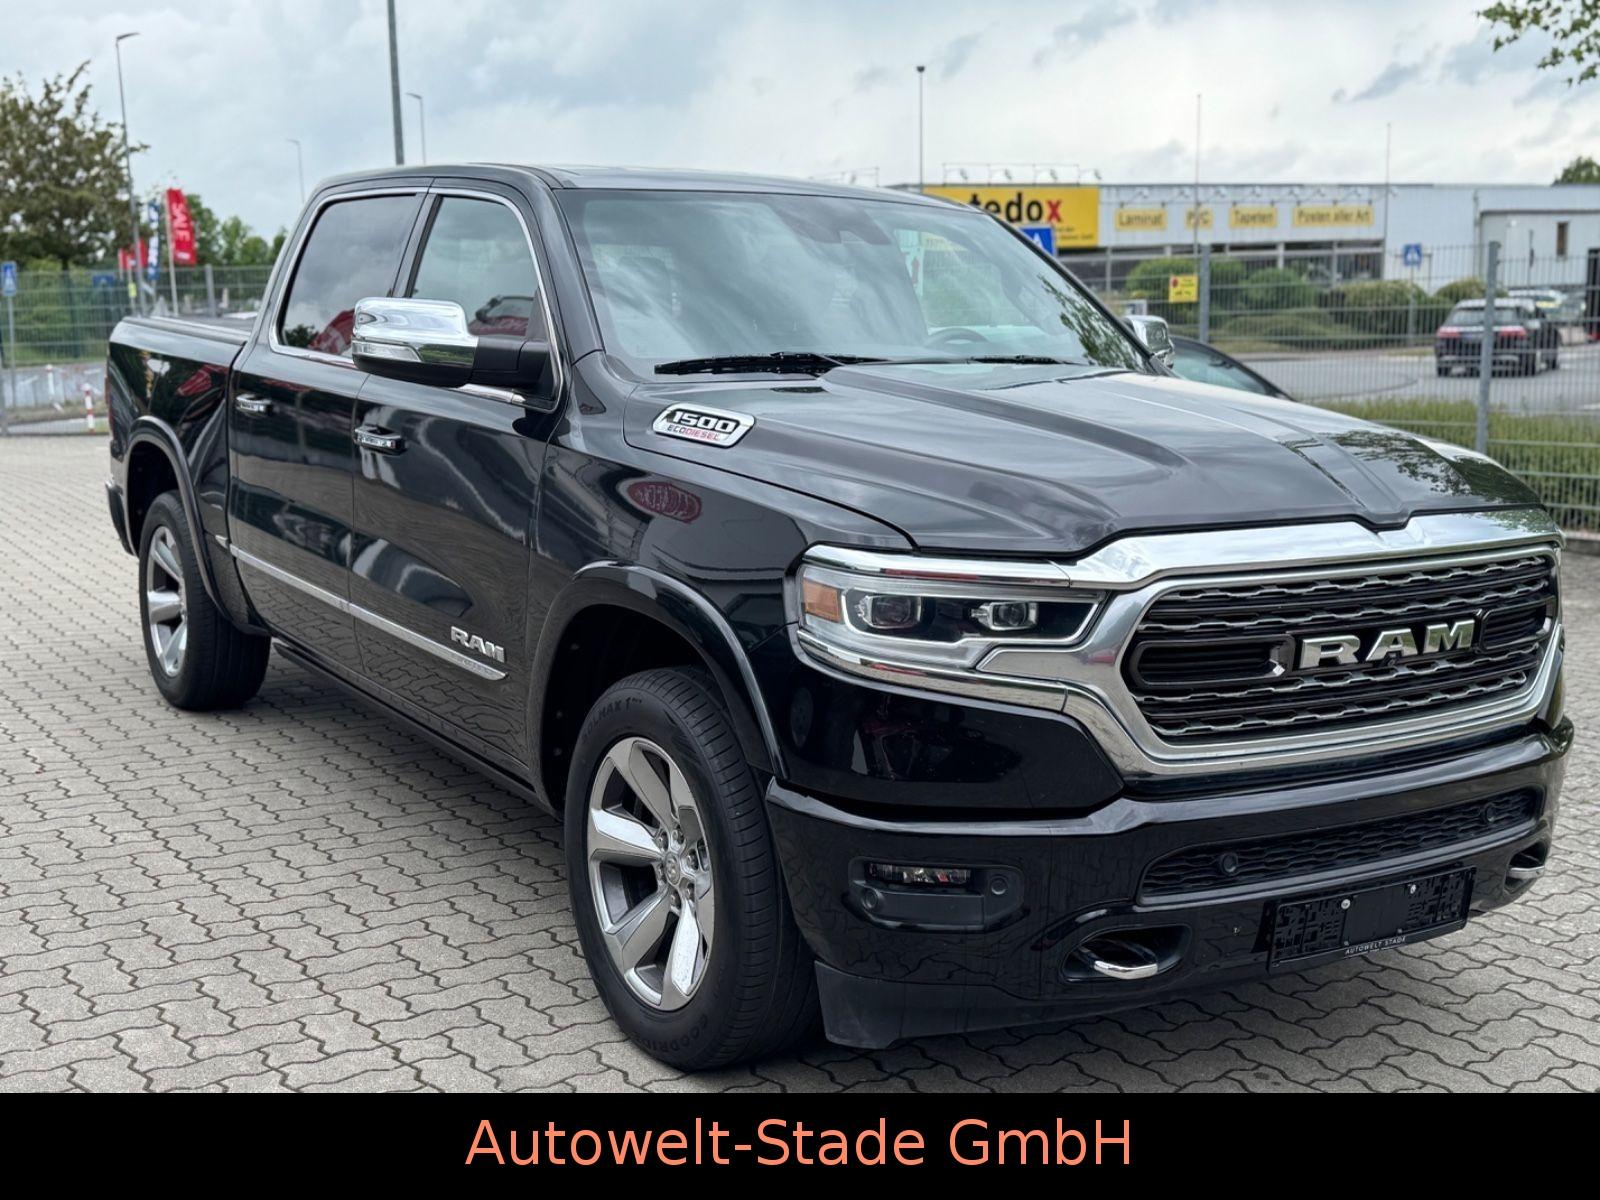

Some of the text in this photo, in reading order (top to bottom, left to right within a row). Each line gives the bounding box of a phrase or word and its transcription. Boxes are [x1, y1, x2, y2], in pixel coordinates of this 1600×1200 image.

[969, 192, 1062, 223] tedox
[1118, 209, 1162, 226] Laminat
[1234, 209, 1274, 225] Tapeten
[1297, 208, 1331, 223] Posten
[172, 203, 191, 241] SALE
[672, 410, 737, 433] 1500
[667, 424, 720, 441] ECODIESEL
[451, 626, 505, 663] RAM
[1300, 619, 1476, 669] RAM
[1345, 941, 1382, 954] AUTOWELT
